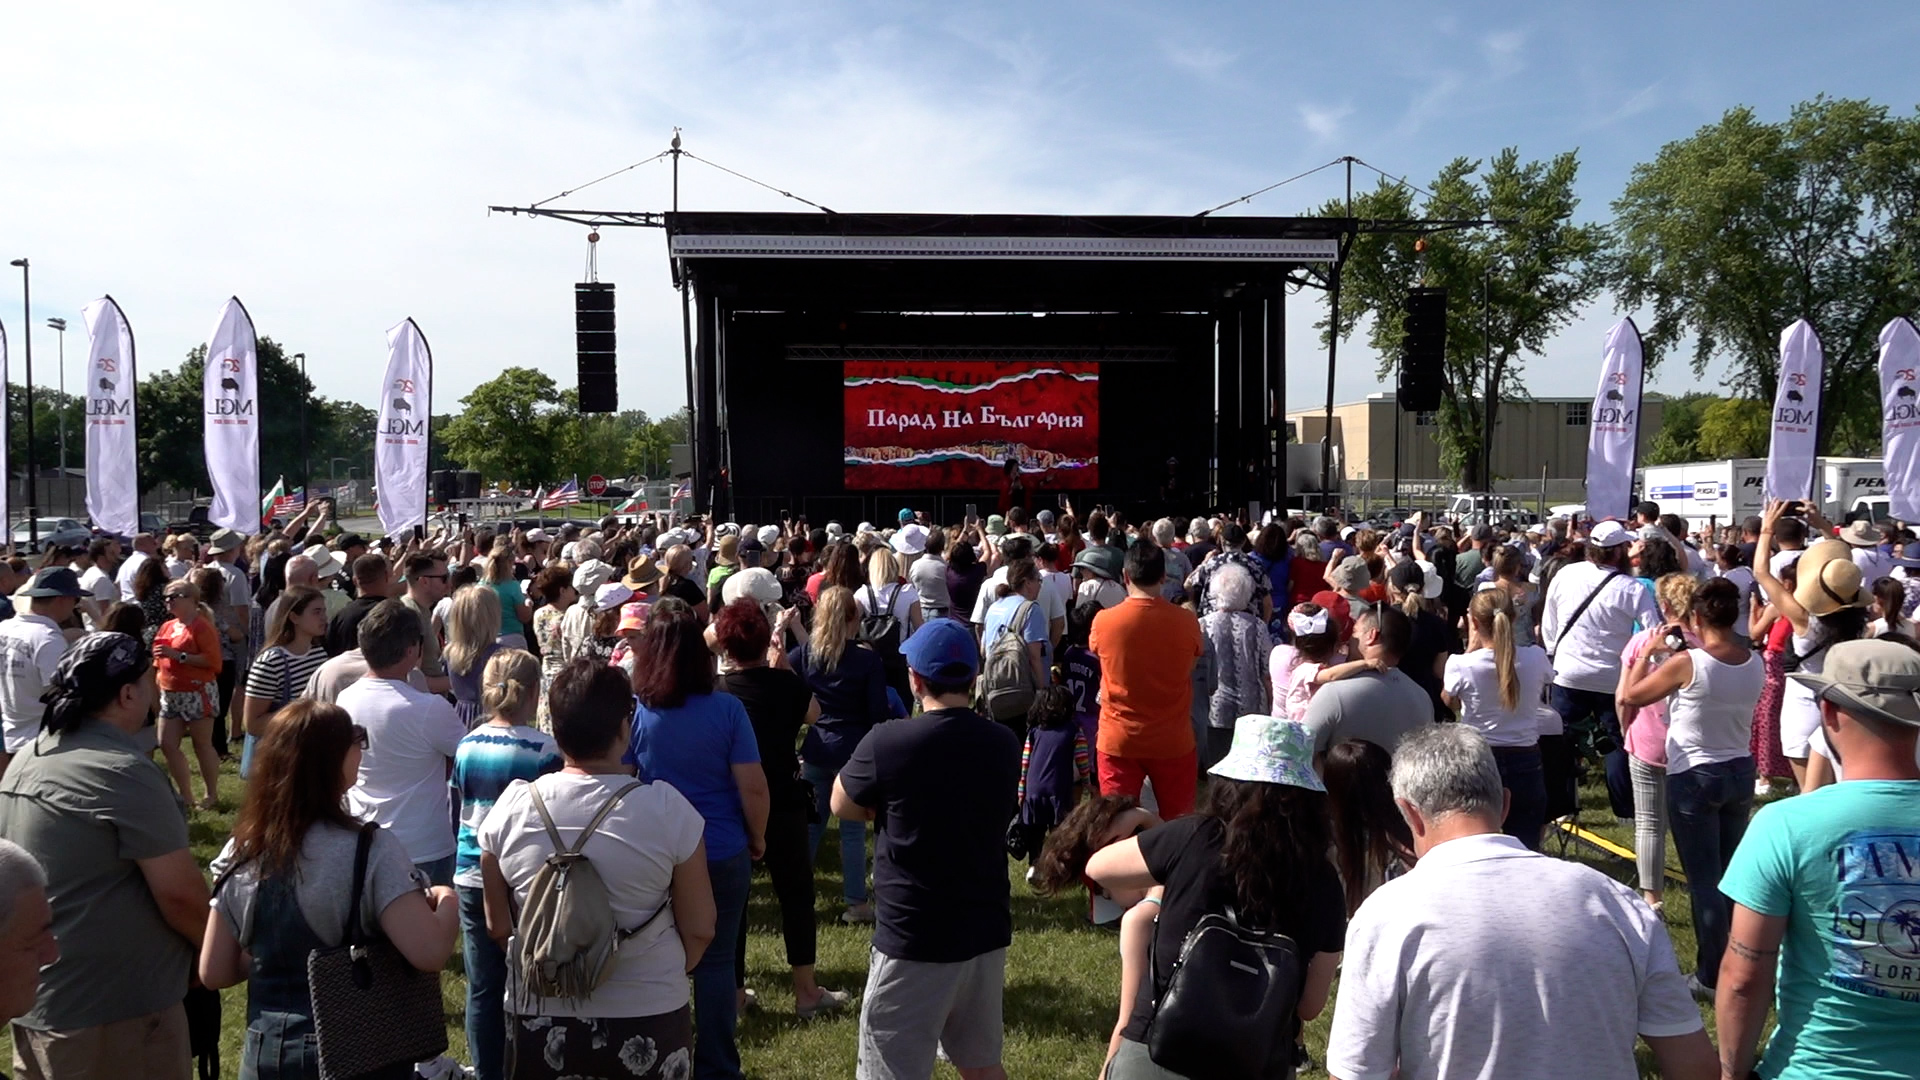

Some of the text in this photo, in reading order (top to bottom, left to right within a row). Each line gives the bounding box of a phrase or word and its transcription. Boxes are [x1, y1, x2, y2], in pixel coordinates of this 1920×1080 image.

[867, 406, 1084, 432] Парад На България
[589, 480, 605, 489] STOP
[1066, 678, 1087, 713] 12
